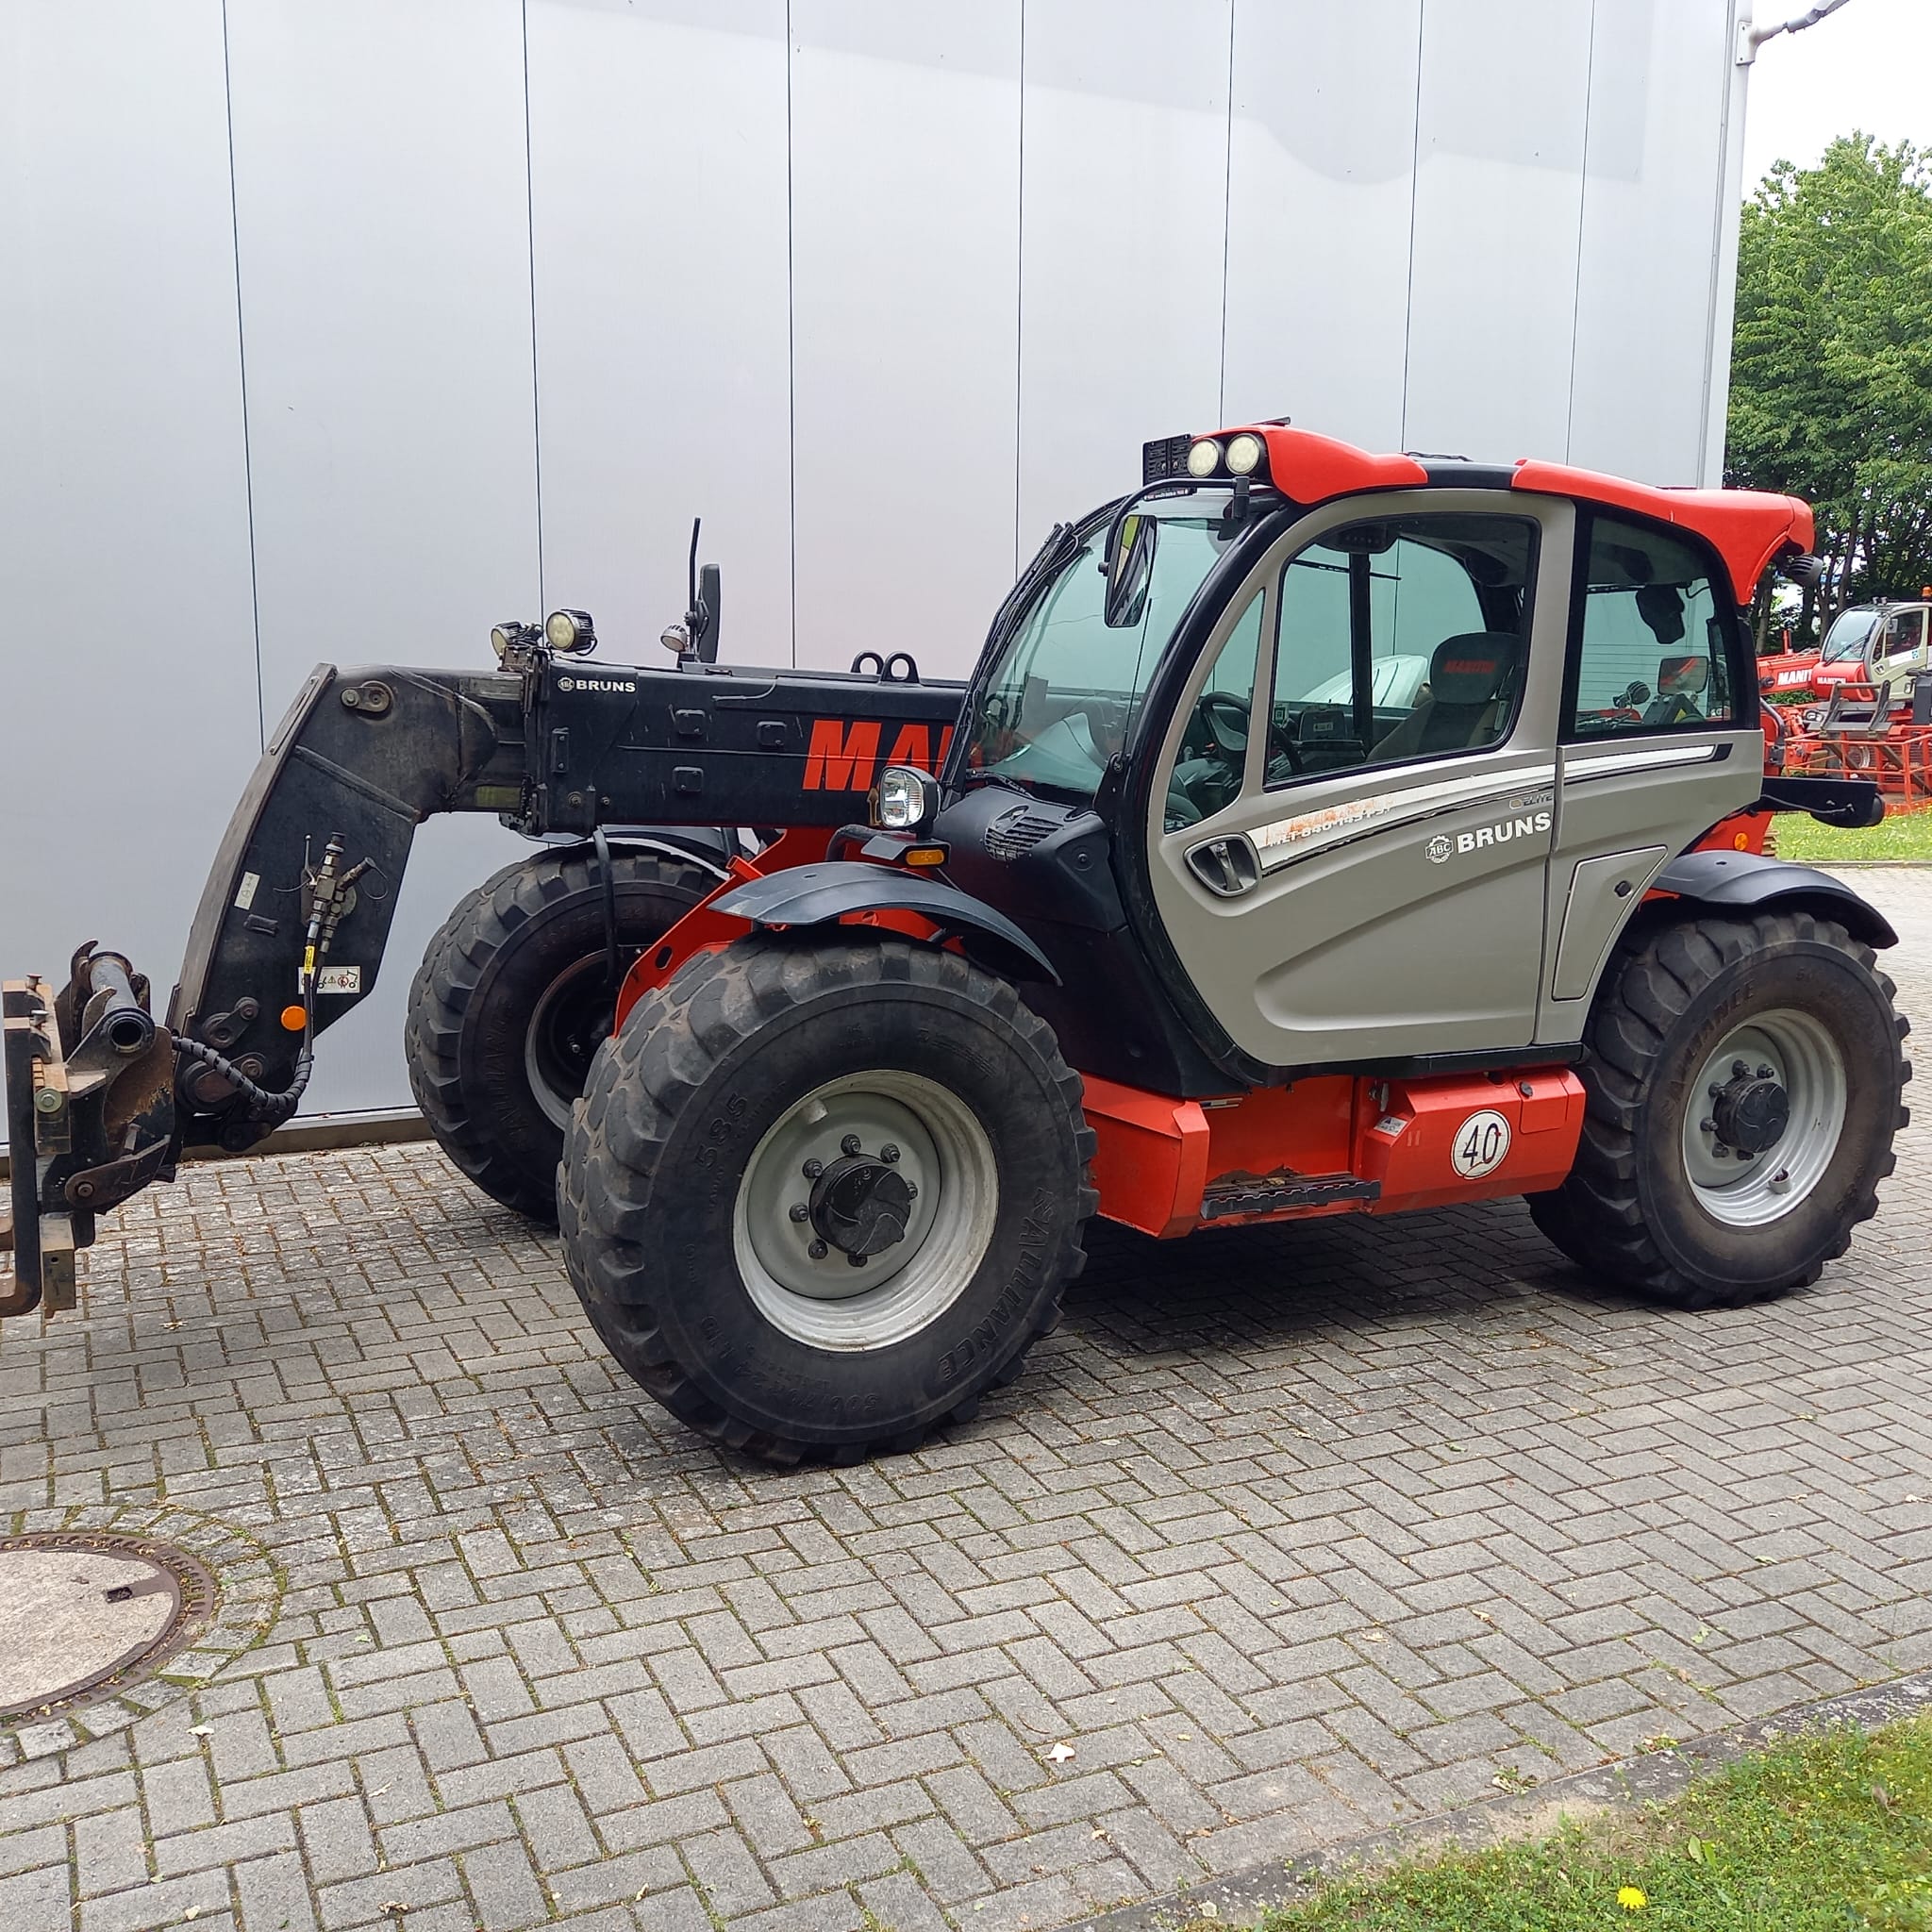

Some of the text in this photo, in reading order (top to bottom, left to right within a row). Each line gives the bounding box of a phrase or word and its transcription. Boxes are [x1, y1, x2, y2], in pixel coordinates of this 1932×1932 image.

[575, 679, 636, 692] BRUNS
[1456, 811, 1552, 854] BRUNS
[1462, 1122, 1499, 1167] 40
